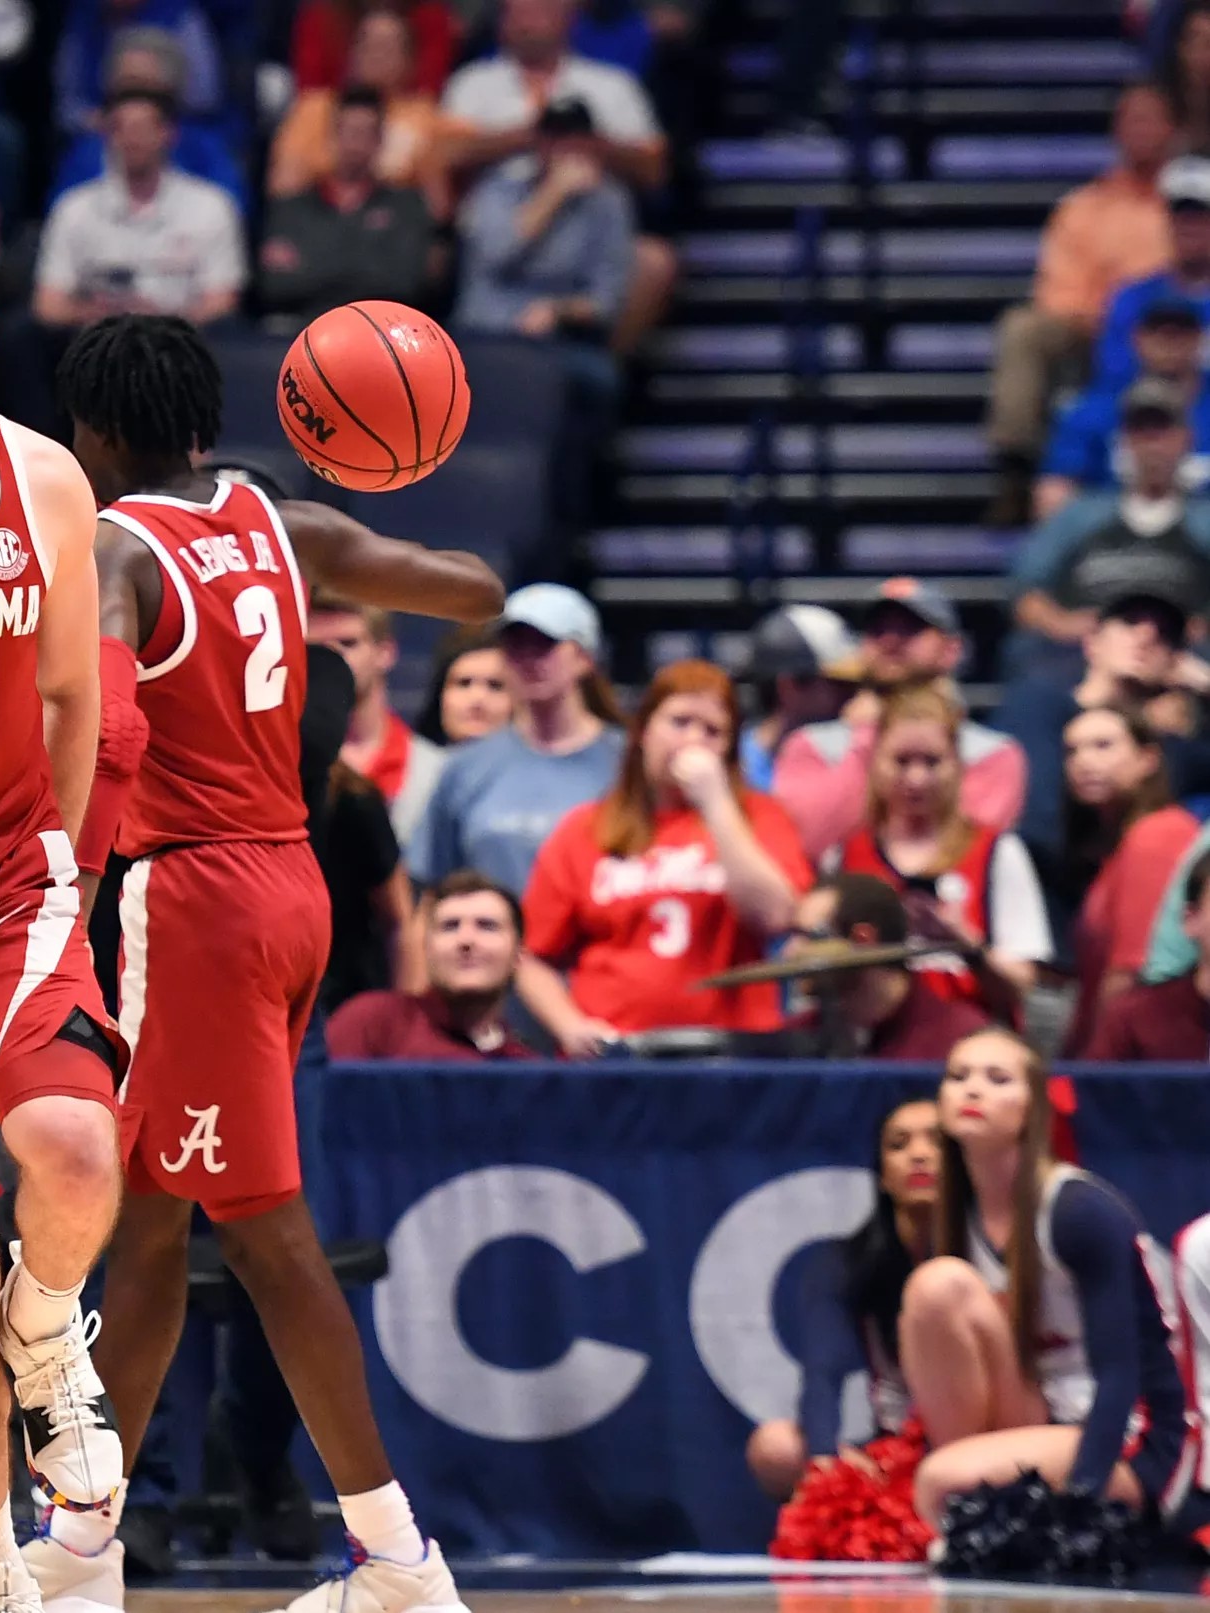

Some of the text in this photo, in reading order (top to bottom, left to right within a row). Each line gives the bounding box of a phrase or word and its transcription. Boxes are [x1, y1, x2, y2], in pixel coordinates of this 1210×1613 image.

[282, 365, 337, 445] NCAA
[232, 585, 288, 713] 2
[648, 898, 691, 959] 3
[160, 1104, 227, 1174] A
